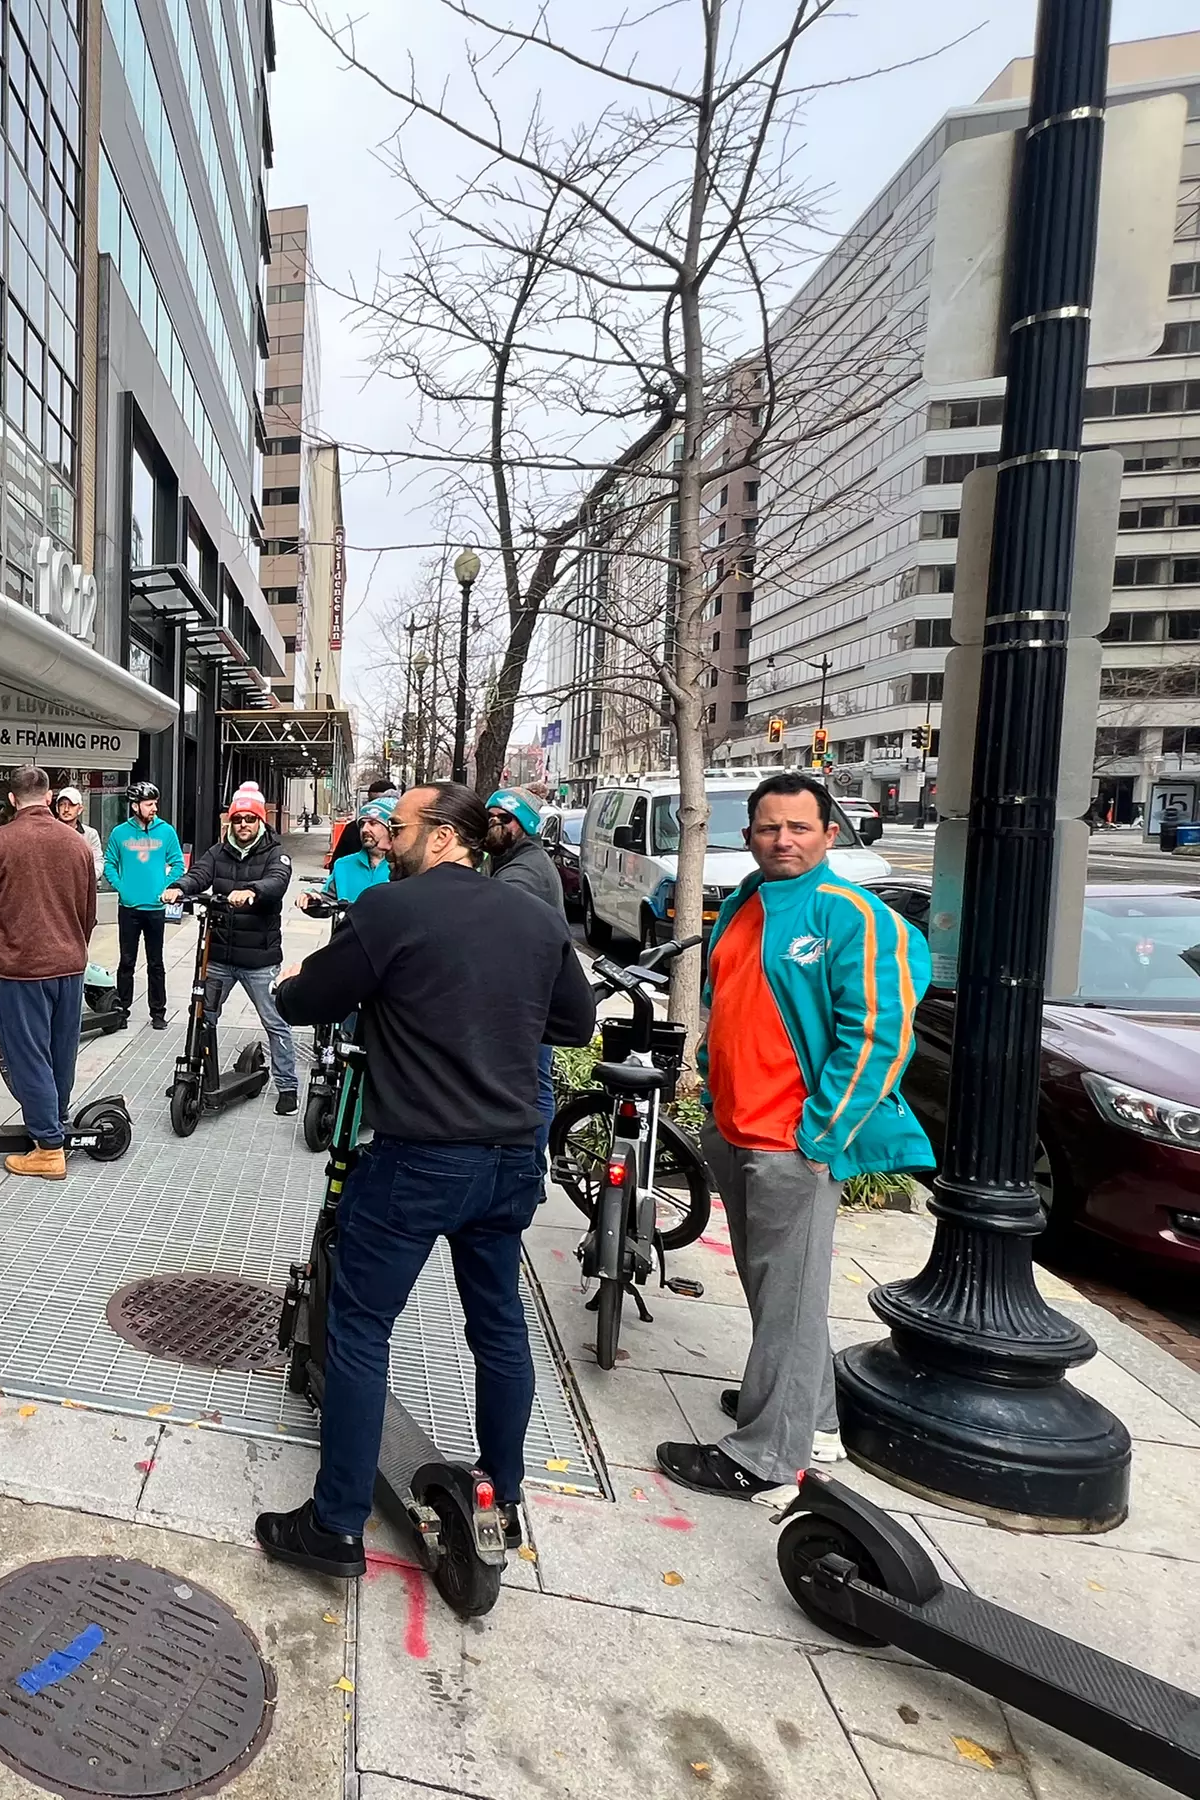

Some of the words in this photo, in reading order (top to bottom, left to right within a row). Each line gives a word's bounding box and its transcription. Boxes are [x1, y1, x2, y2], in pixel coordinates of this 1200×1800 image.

[332, 615, 341, 640] Inn
[0, 728, 12, 745] &
[16, 729, 87, 750] FRAMING
[90, 734, 121, 751] PRO
[1157, 793, 1188, 812] 15
